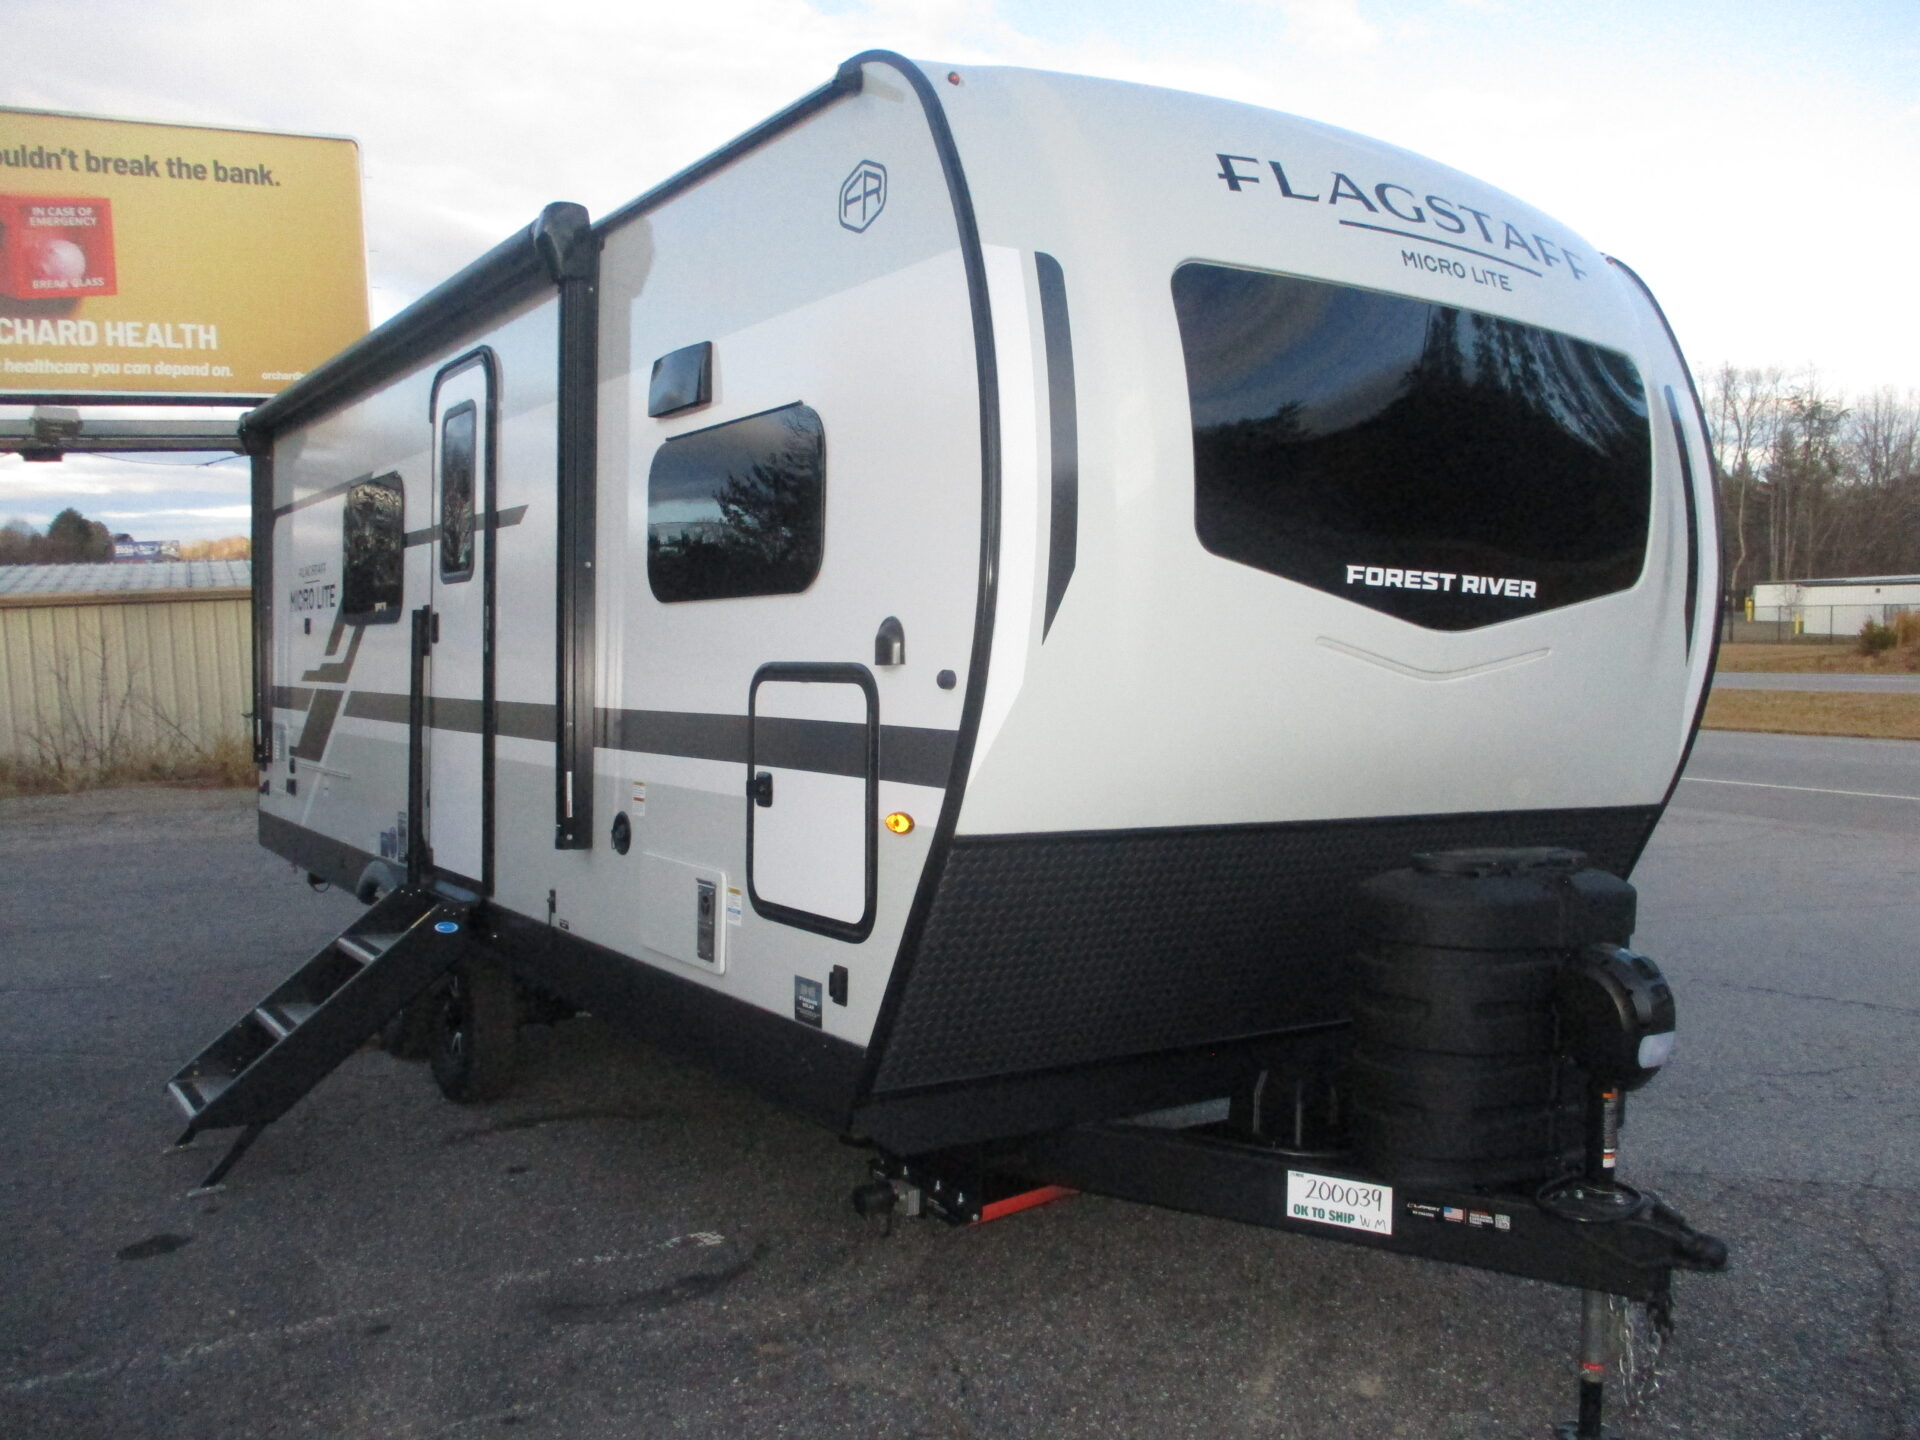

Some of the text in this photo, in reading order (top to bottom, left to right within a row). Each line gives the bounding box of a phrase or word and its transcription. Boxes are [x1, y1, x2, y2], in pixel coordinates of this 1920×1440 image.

[85, 149, 160, 177] break
[166, 157, 208, 180] the
[213, 159, 281, 186] bank.
[29, 216, 97, 227] EMERGENCY
[32, 206, 93, 217] IN CASE OF
[1216, 153, 1587, 281] FLAGSTAFF
[33, 277, 105, 290] BREAK GLASS
[1401, 250, 1513, 292] MICRO LITE
[104, 320, 218, 350] HEALTH
[4, 358, 233, 378] healthcare you can depend on.
[1346, 565, 1537, 598] FOREST RIVER
[290, 584, 336, 610] MICRO LITE
[1305, 1179, 1383, 1212] 200039
[1293, 1203, 1356, 1224] OK TO SHIP
